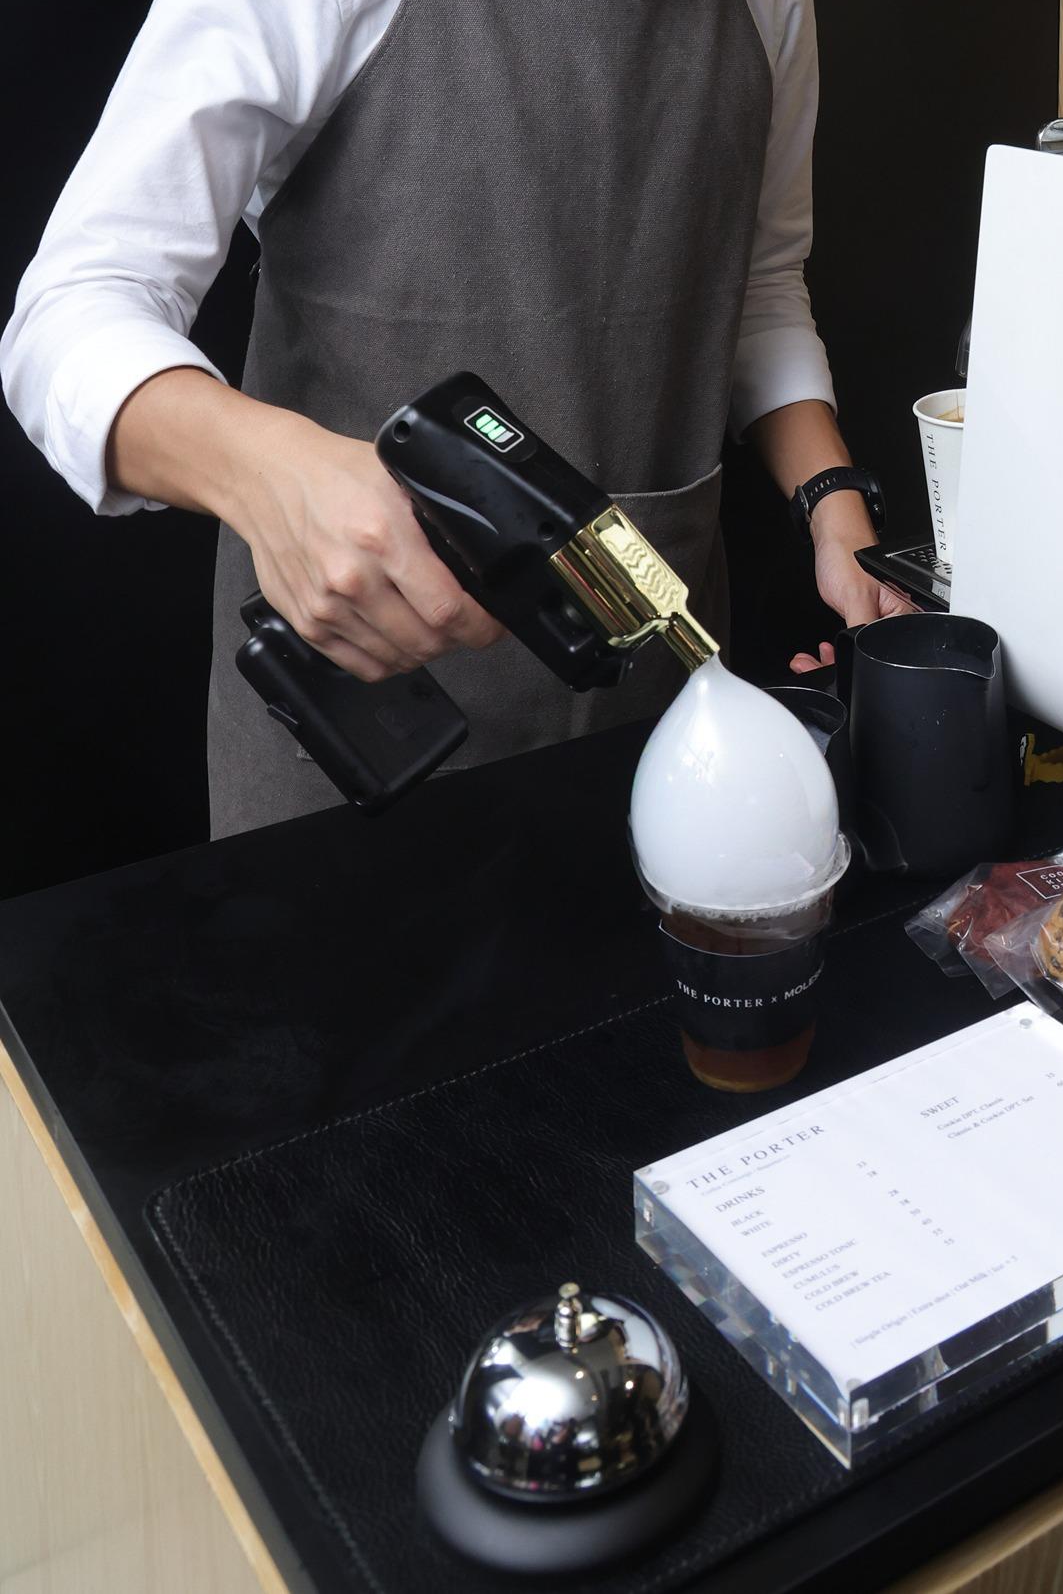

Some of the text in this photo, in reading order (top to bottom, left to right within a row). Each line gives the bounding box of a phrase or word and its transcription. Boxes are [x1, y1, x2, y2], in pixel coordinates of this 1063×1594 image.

[926, 434, 947, 551] THE PORTER
[676, 979, 698, 999] THE
[704, 994, 763, 1008] PORTER
[919, 1096, 962, 1118] SWEET
[686, 1165, 733, 1190] THE
[739, 1123, 825, 1166] PORTER
[715, 1186, 765, 1212] DRINKS
[731, 1209, 763, 1226] BLACK
